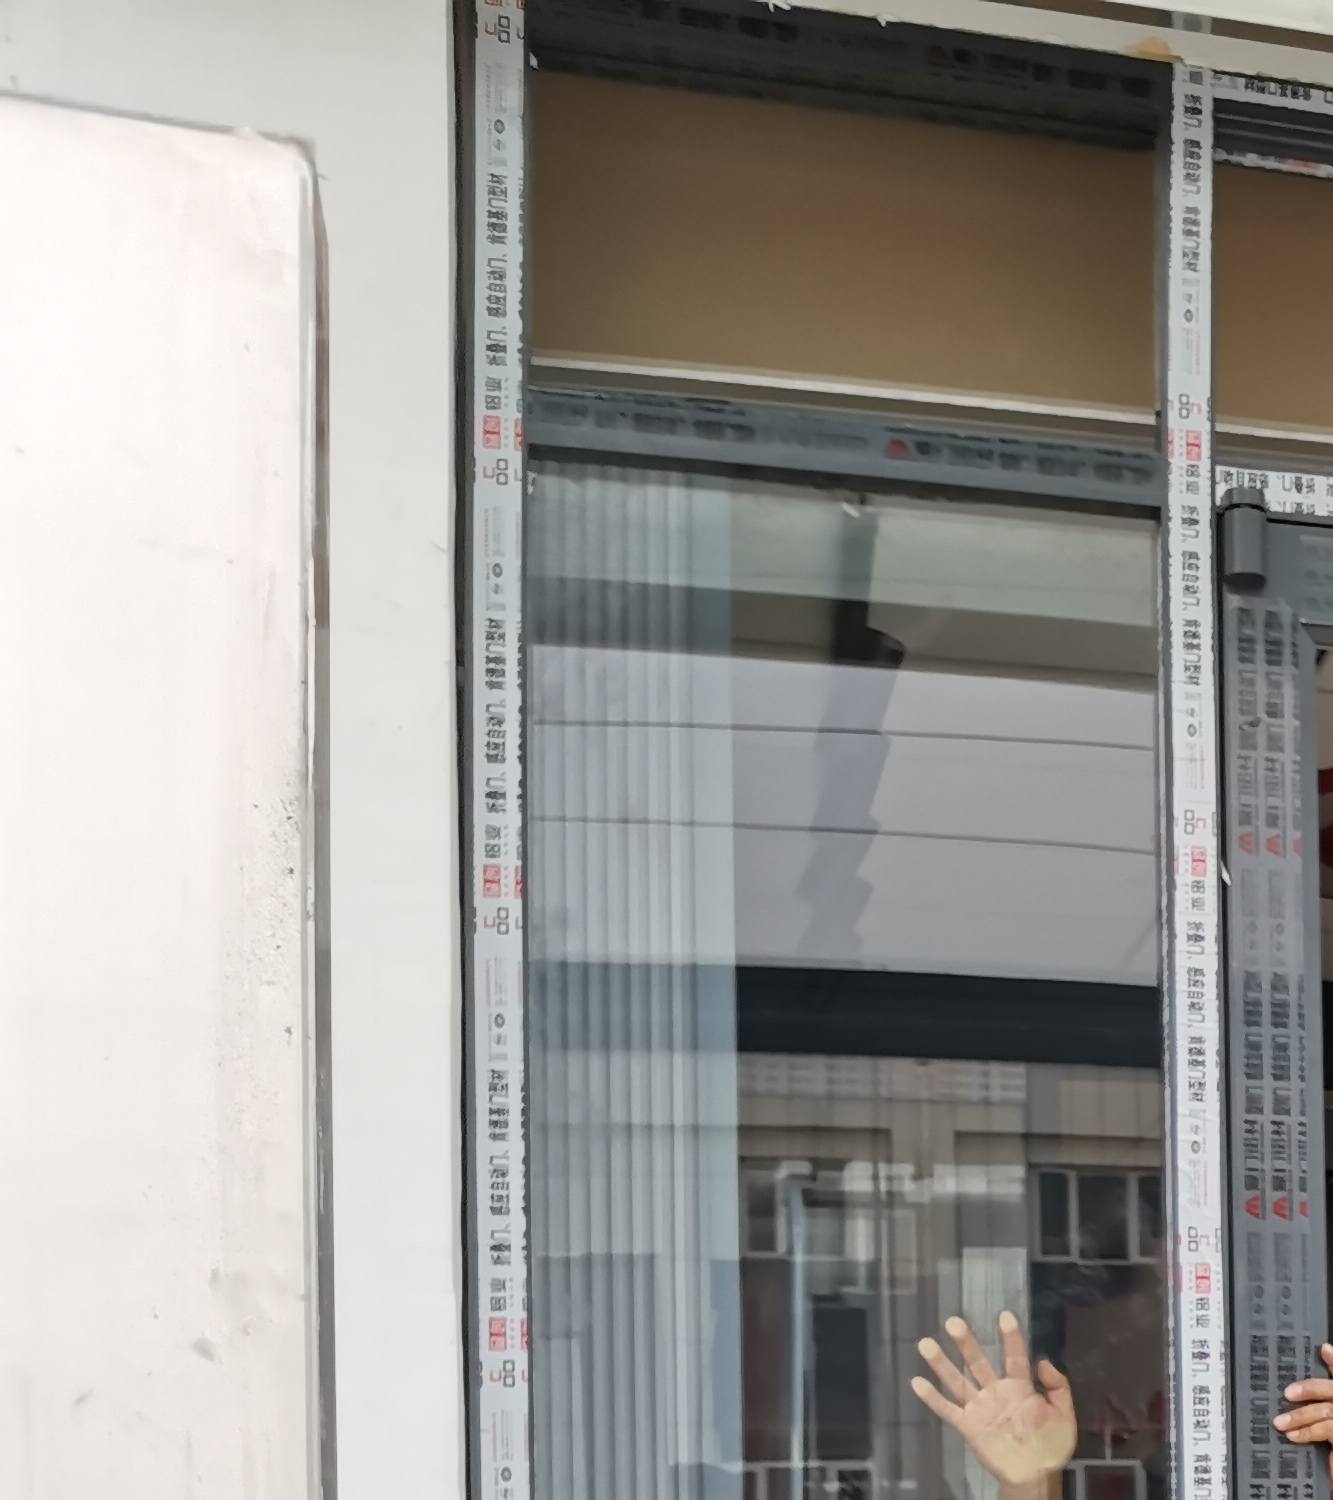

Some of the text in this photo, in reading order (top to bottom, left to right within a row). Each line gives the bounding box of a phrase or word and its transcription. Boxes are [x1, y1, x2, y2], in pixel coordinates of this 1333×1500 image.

[487, 173, 507, 365] 折叠门、感应自动门、肯德基门型材
[1182, 504, 1200, 685] 折叠门、感应自动门、肯德基门型材
[485, 617, 506, 814] 折叠门、感应自动门、肯德基门型材
[1188, 921, 1205, 1102] 折叠门、感应自动门、肯德基门型材
[489, 1069, 509, 1266] 折叠门、感应自动门、肯德基门型材
